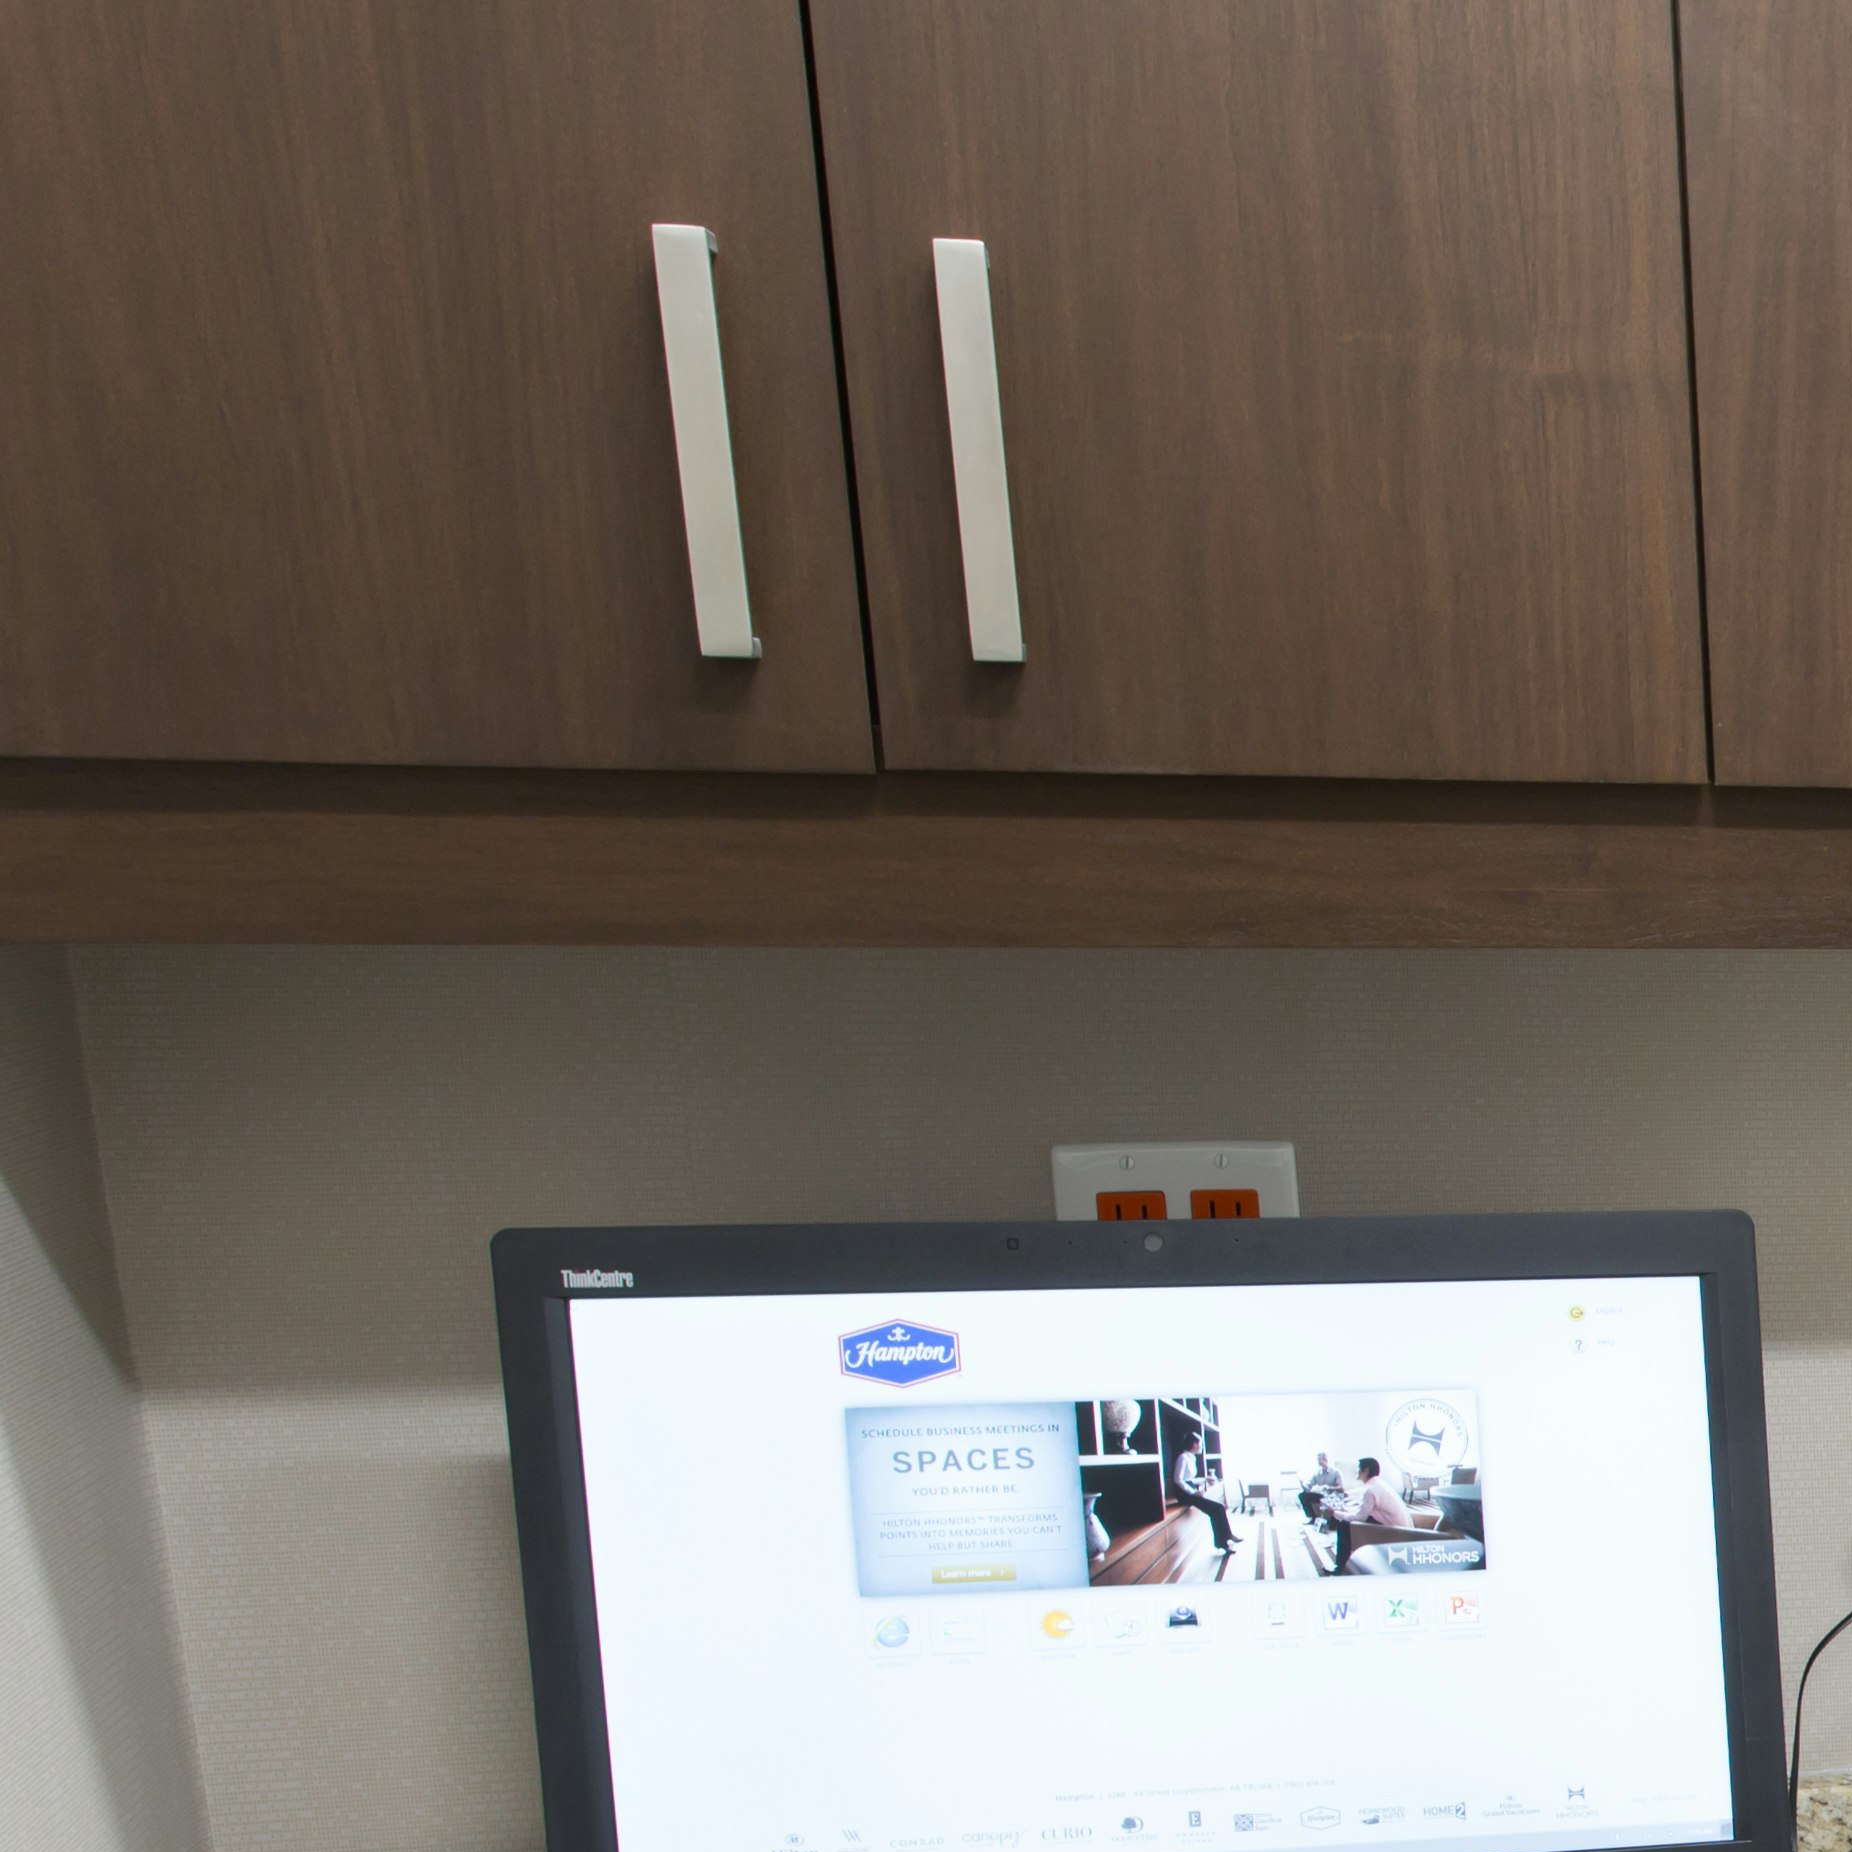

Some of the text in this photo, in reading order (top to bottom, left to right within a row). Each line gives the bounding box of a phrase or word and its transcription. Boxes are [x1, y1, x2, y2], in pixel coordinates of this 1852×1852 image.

[560, 1269, 634, 1289] ThinkCentre
[844, 1340, 955, 1369] Hampton
[861, 1423, 1060, 1439] SCHEDULE BUSINESS MEETINGS IN
[892, 1447, 1036, 1474] SPACES
[912, 1485, 949, 1496] YOU'D
[953, 1484, 999, 1495] RATHER
[883, 1518, 920, 1529] HILTON
[988, 1513, 1058, 1524] TRANSFORMS
[880, 1525, 1062, 1541] POINTS INTO MEMORIES YOU CAN'T
[928, 1541, 955, 1551] HELP
[957, 1541, 977, 1551] BUT
[1412, 1544, 1445, 1554] HILTON
[1412, 1551, 1480, 1565] HHONORS
[940, 1569, 992, 1579] Learn more
[961, 1830, 1022, 1848] canopy
[1041, 1827, 1093, 1841] CURIO
[890, 1836, 945, 1849] CONRAD
